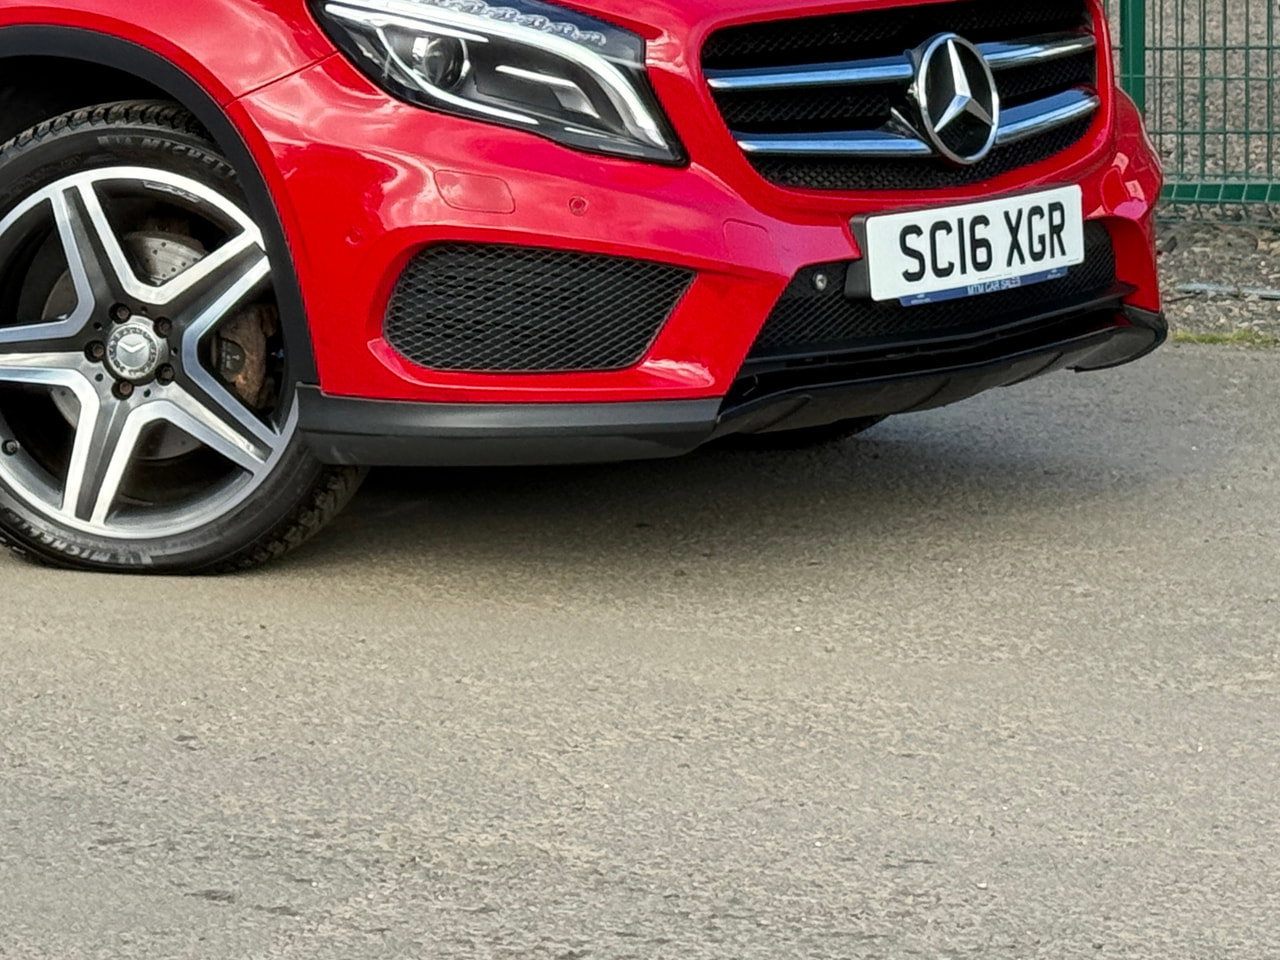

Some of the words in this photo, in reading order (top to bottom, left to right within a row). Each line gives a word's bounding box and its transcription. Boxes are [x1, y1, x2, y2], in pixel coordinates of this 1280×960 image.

[899, 214, 993, 283] SC16
[1003, 201, 1066, 267] XGR
[967, 283, 985, 296] MTM
[985, 280, 1000, 293] CAR
